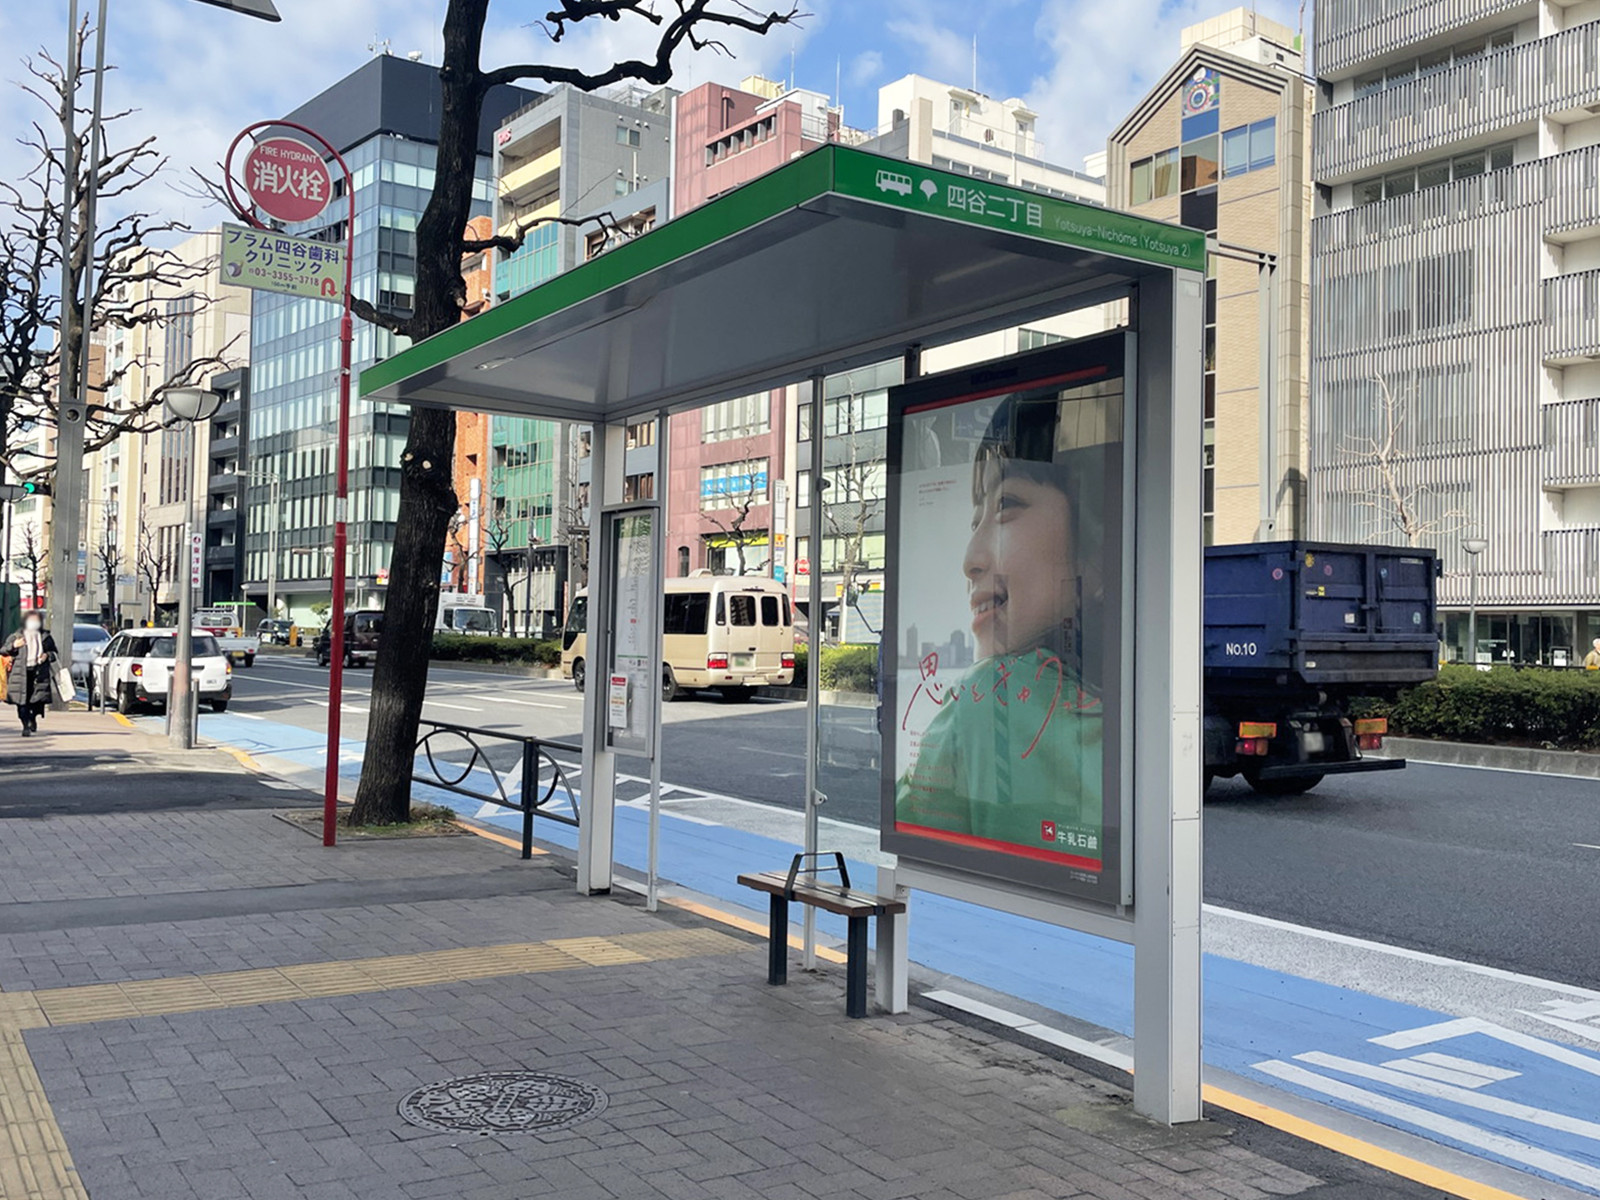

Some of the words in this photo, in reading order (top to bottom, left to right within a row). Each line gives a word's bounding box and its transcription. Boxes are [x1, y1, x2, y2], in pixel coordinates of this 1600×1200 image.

[260, 145, 278, 158] FIRE
[280, 146, 318, 165] HYDRANT
[252, 159, 325, 202] 消火栓
[947, 184, 1042, 228] 四谷二丁目
[227, 229, 339, 264] プラム四谷歯科
[1054, 215, 1138, 247] Yotsuya-Nichome
[1139, 234, 1179, 257] (Yotsuya
[245, 249, 323, 275] クリニック
[254, 267, 320, 286] 03-3355-3718
